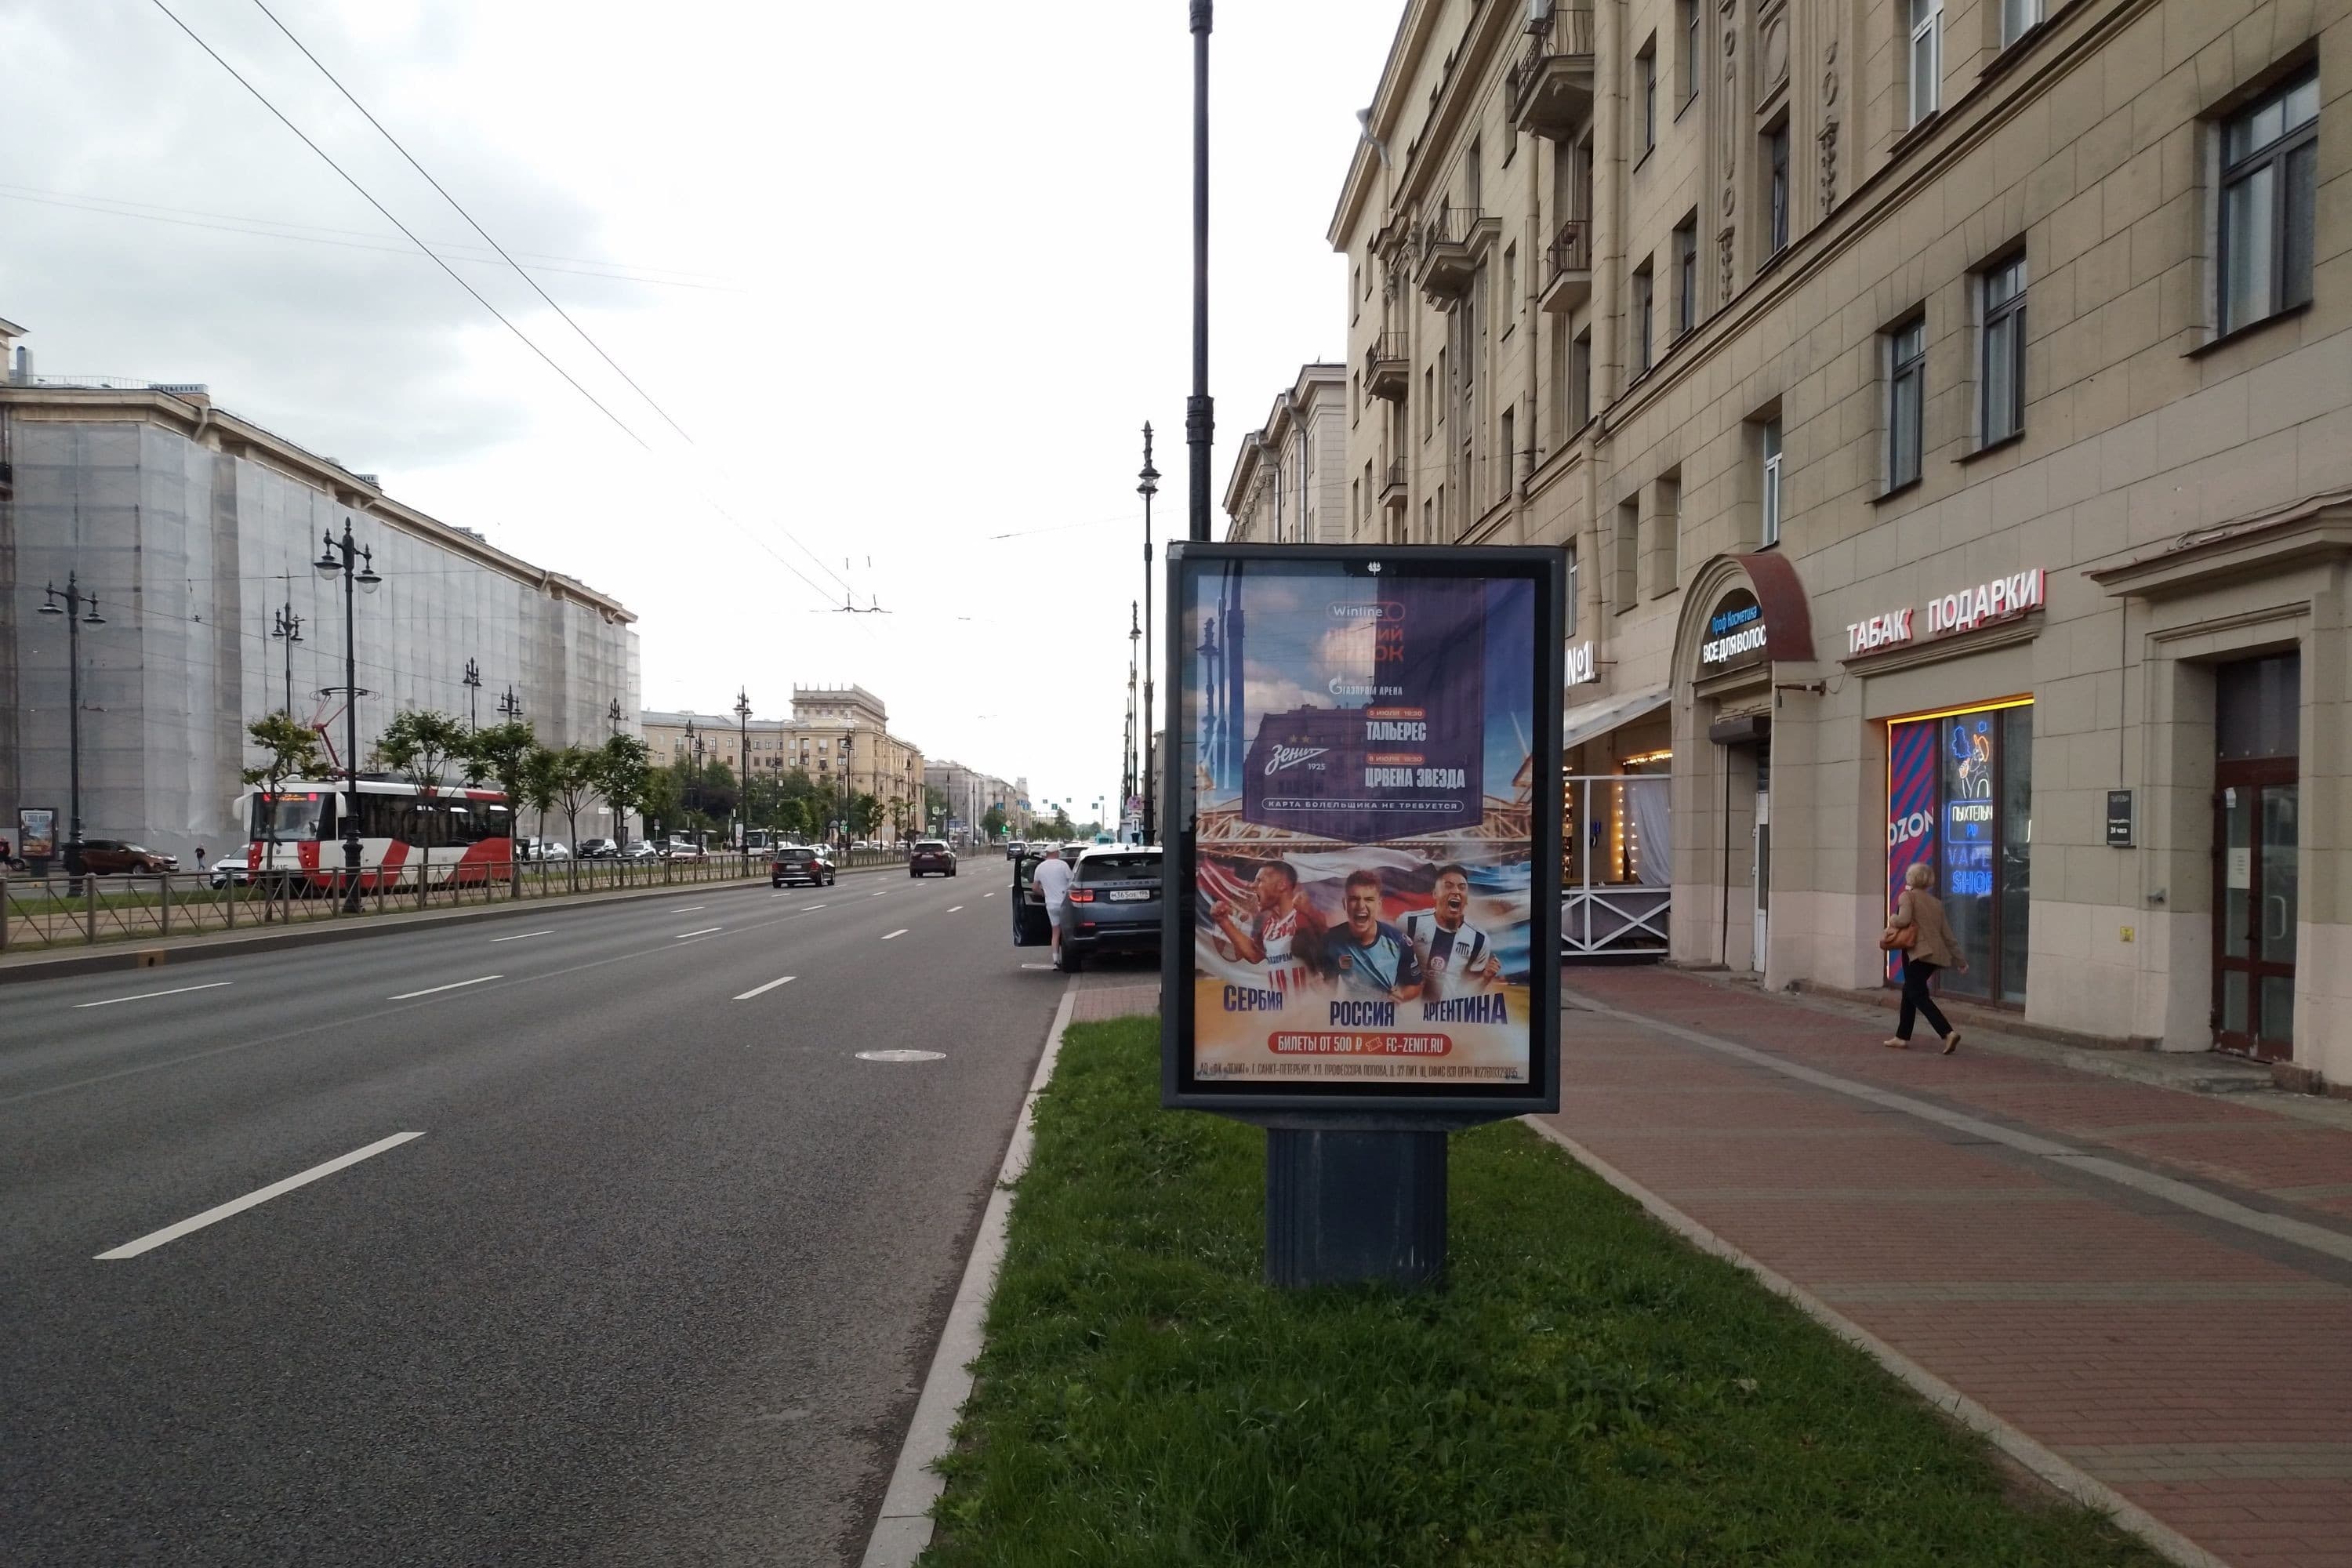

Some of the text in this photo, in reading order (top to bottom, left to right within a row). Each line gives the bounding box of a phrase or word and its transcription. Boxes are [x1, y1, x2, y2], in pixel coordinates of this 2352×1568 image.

[1333, 605, 1383, 617] Winline
[1847, 568, 2043, 653] ТАБАК ПОДАРКИ
[1703, 624, 1767, 664] ВСЕ ДЛЯ ВОЛОС
[1366, 721, 1427, 742] ТАЛЬЕРЕС
[1365, 768, 1466, 789] ЦРВЕНА ЗВЕЗДА
[1305, 800, 1378, 809] БОЛЕЛЬЩИКА
[1223, 985, 1283, 1012] СЕРБИЯ
[1422, 993, 1508, 1025] АРГЕНТИНА
[1330, 1000, 1395, 1027] РОССИЯ
[1277, 1036, 1317, 1052] БИЛЕТЫ
[1319, 1036, 1331, 1052] ОТ
[1334, 1036, 1352, 1052] 500
[1385, 1037, 1443, 1054] FC-ZENIT.RU
